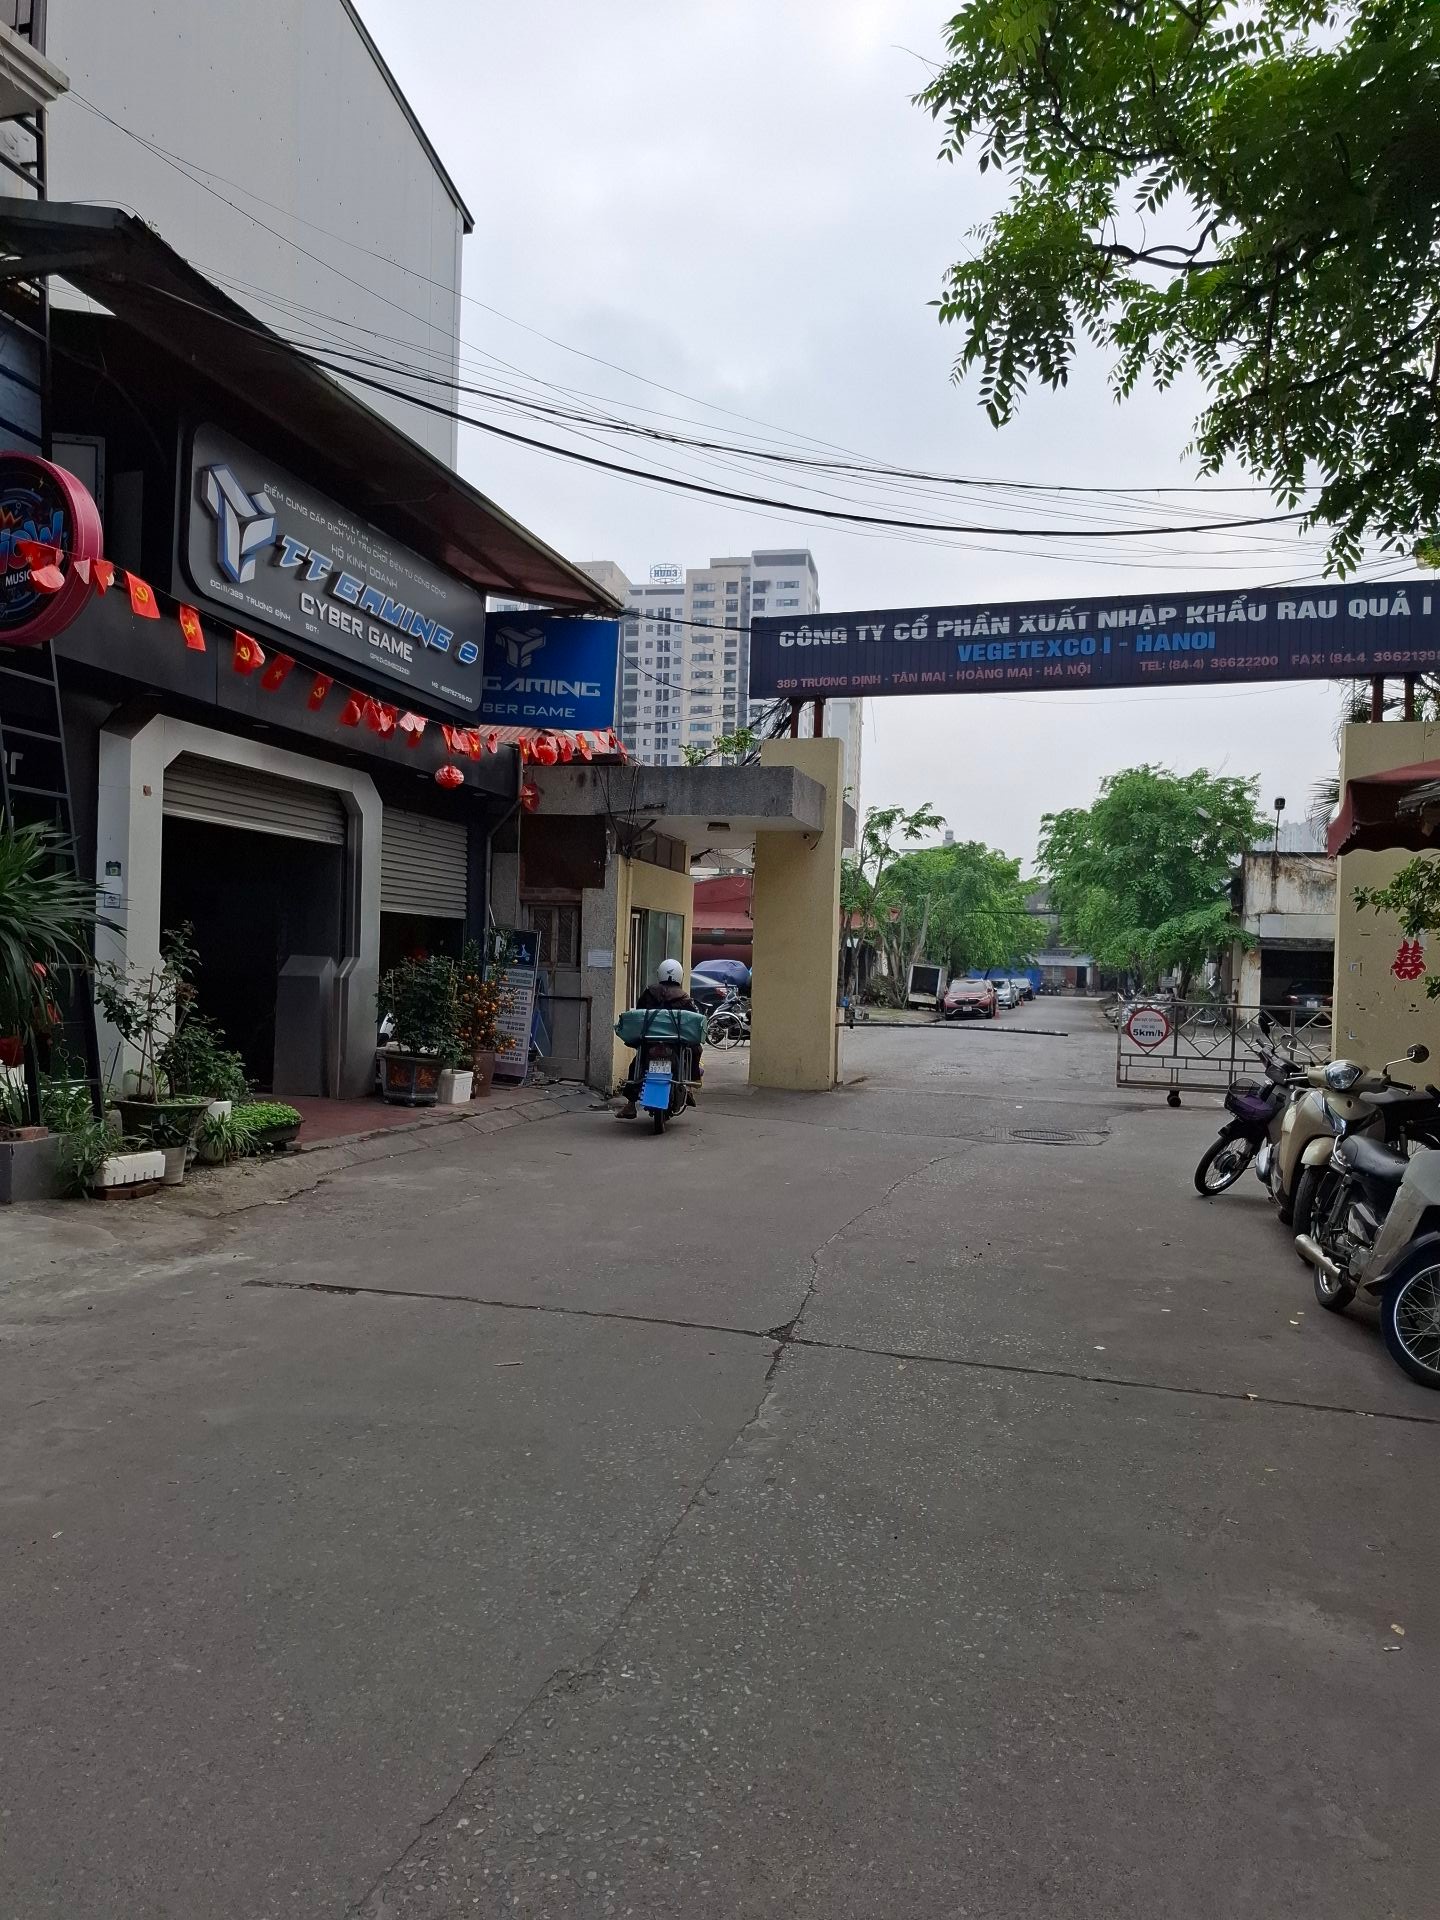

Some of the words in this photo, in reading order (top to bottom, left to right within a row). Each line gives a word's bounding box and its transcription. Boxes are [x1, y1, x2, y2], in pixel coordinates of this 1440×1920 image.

[285, 497, 308, 517] CUNG
[5, 569, 32, 588] MUSIC
[346, 553, 367, 573] KINH
[369, 567, 398, 589] DOANH
[301, 592, 364, 640] CYBER
[368, 626, 413, 662] GAME
[334, 571, 454, 652] GAMING
[458, 640, 479, 665] 2
[779, 625, 847, 647] CÔNG
[856, 624, 885, 642] TY
[893, 614, 930, 641] CỔ
[937, 611, 1010, 638] PHẦN
[1018, 605, 1091, 633] XUẤT
[1097, 604, 1177, 630] NHẬP
[1186, 595, 1267, 624] KHẨU
[1277, 599, 1338, 620] RAU
[1348, 590, 1412, 619] QUẢ
[1422, 596, 1432, 615] I
[957, 637, 1096, 662] VEGETEXCO
[1103, 636, 1111, 654] I
[1135, 631, 1216, 652] HANOI
[1140, 661, 1166, 671] TEL:
[1210, 656, 1279, 668] 36622200
[1291, 654, 1325, 665] FAX:
[482, 676, 601, 698] GAMING
[776, 679, 798, 689] 389
[851, 674, 881, 687] ĐỊNH
[892, 672, 918, 683] TÂN
[956, 667, 1003, 681] HOÀNG
[1066, 662, 1091, 676] NỘI
[523, 705, 576, 718] GAME
[1133, 1028, 1164, 1037] 5km/h
